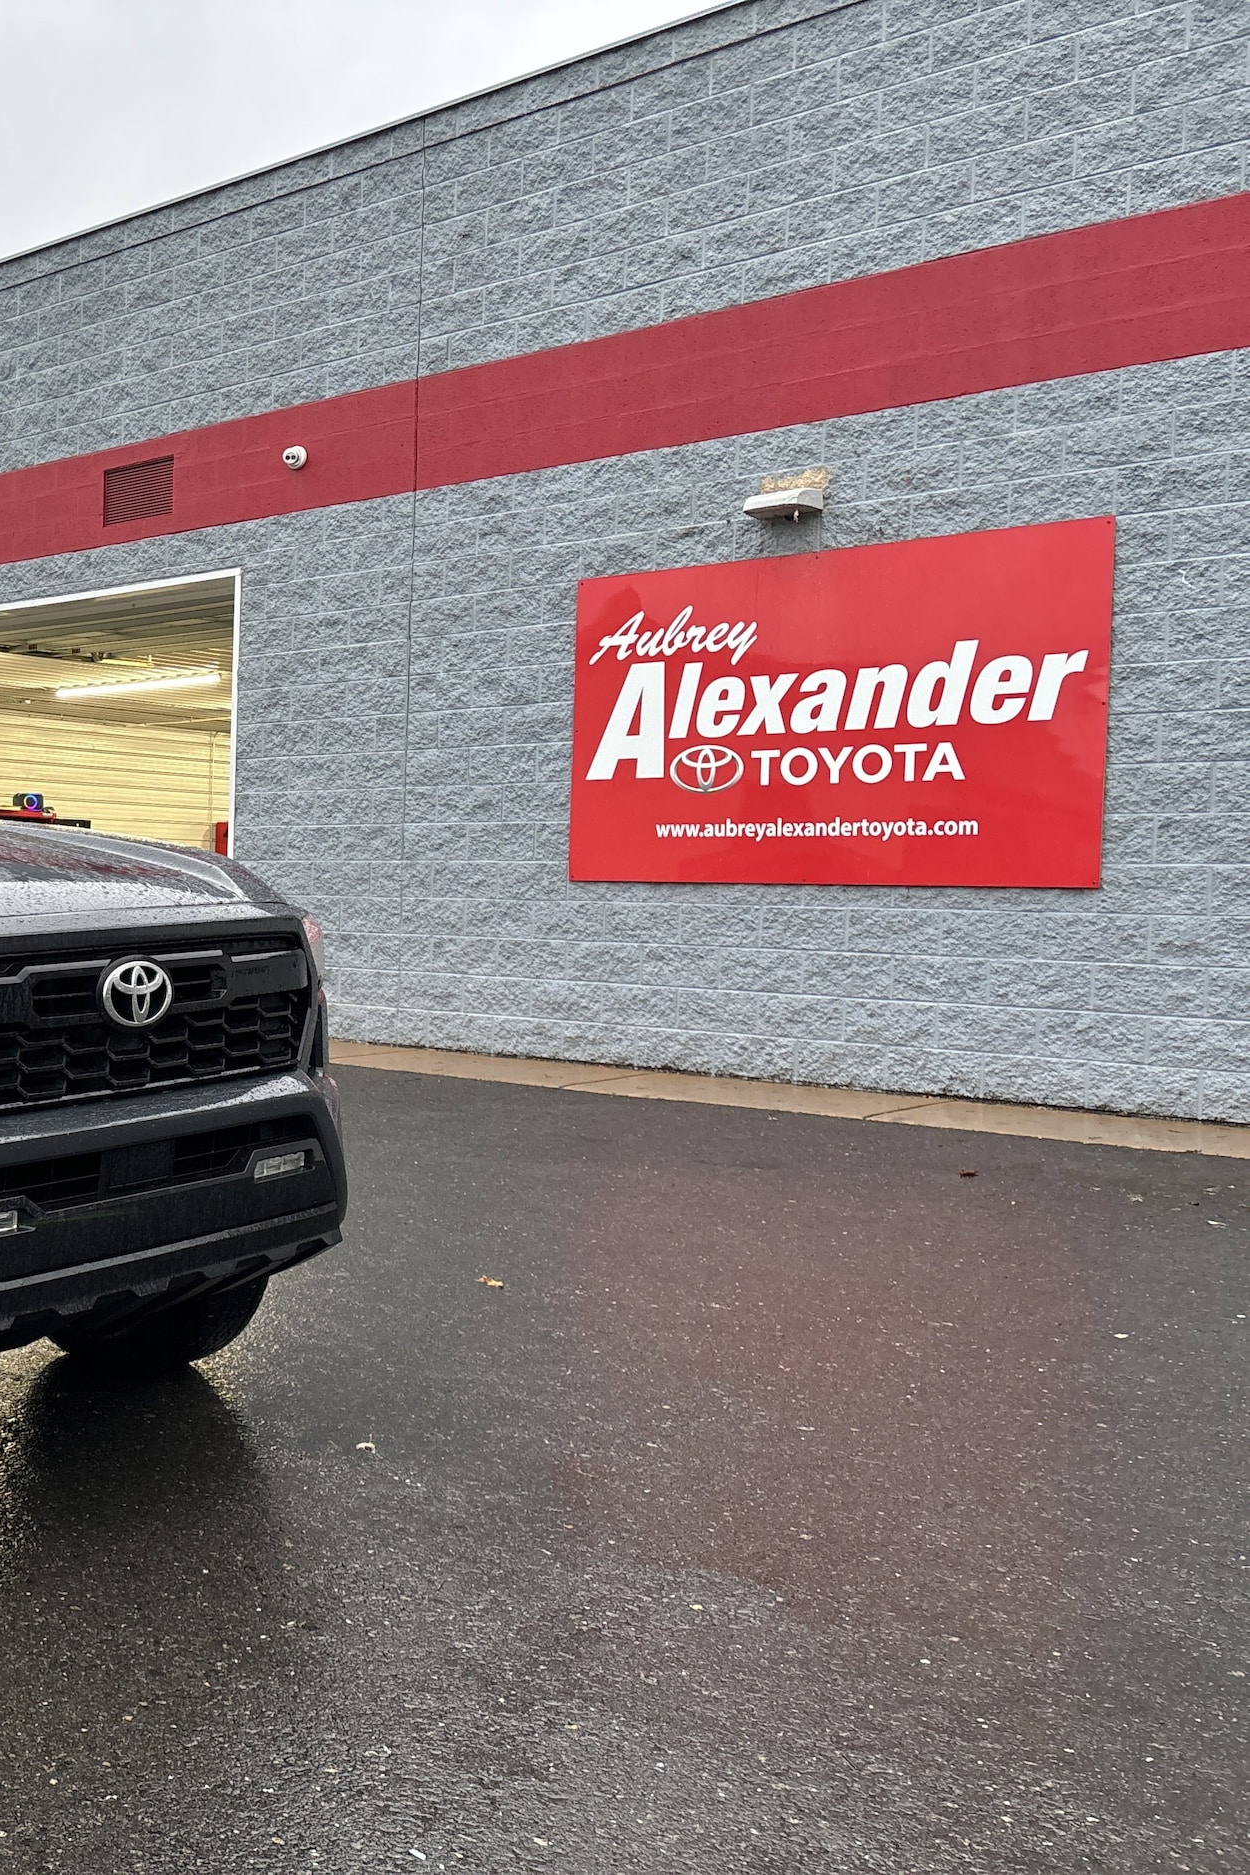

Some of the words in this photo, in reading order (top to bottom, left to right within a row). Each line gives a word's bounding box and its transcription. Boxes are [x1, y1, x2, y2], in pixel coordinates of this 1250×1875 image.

[589, 605, 758, 666] Aubrey
[585, 639, 1089, 781] Alexander
[751, 742, 966, 786] TOYOTA
[655, 817, 979, 842] www.aubreyalexandertoyota.com
